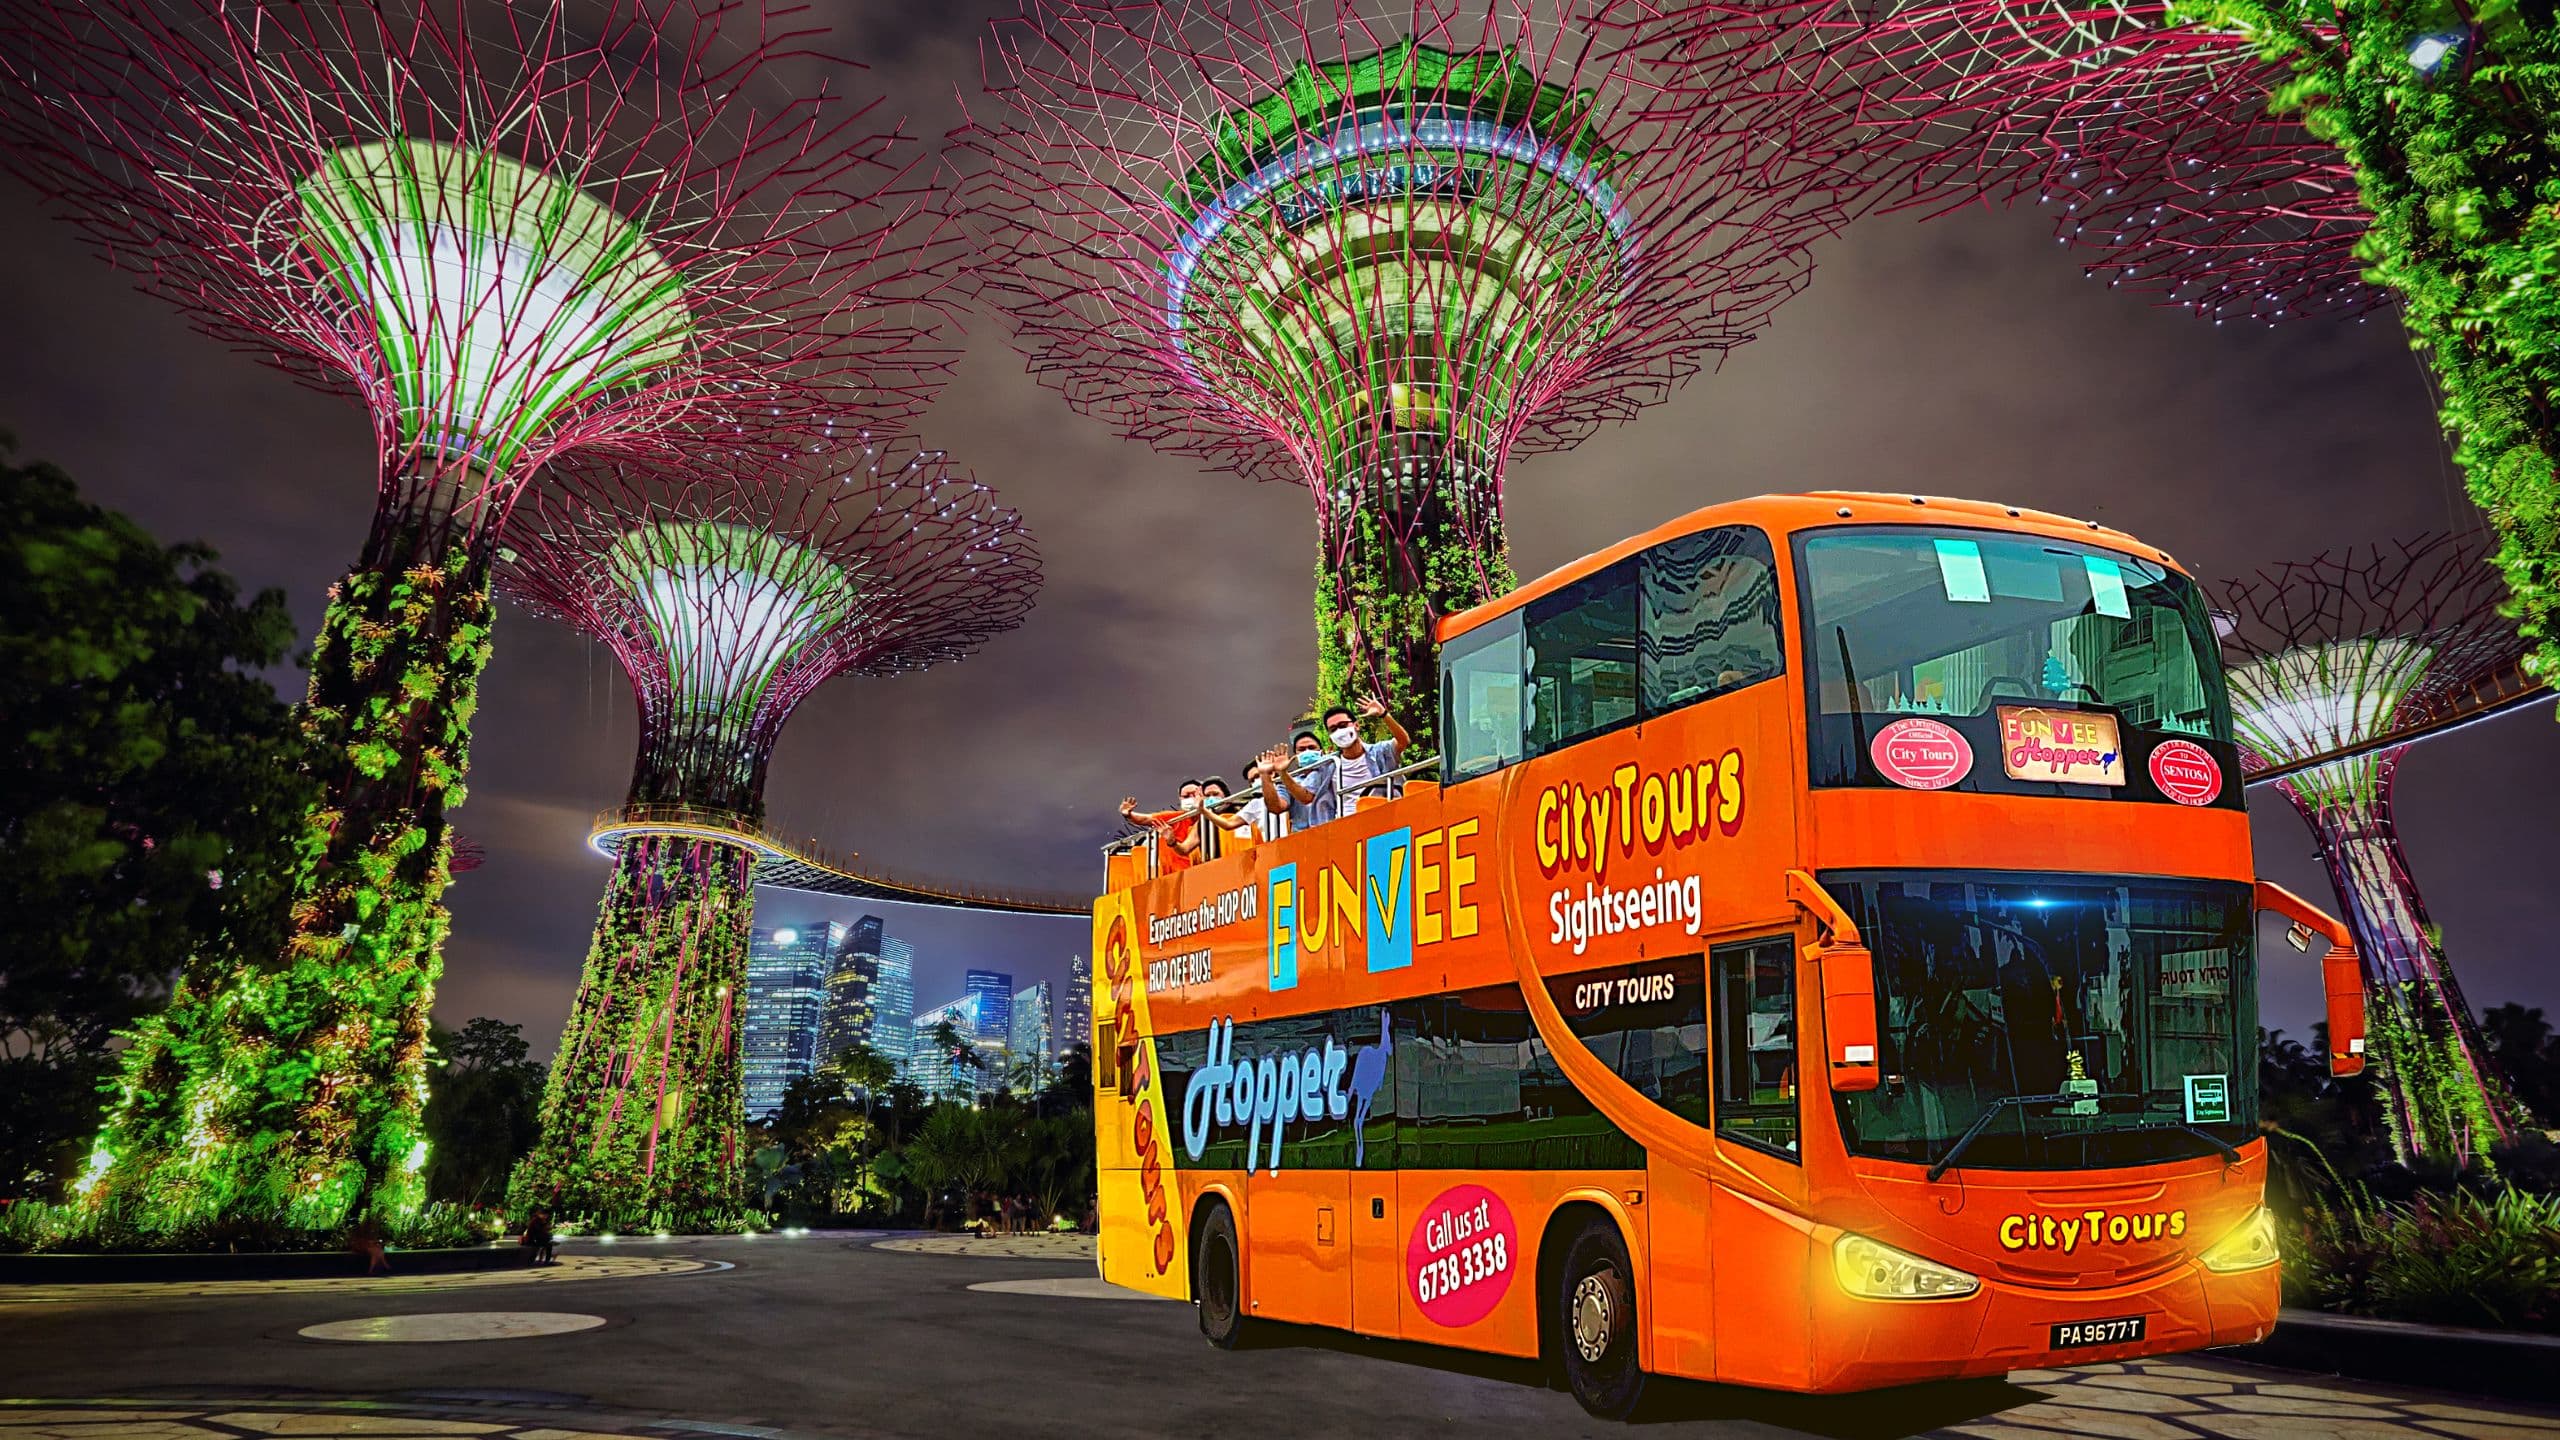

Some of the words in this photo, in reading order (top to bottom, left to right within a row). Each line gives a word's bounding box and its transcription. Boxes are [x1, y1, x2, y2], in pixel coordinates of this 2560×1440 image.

[1892, 748, 1917, 762] City
[1920, 748, 1953, 760] Tours
[2011, 737, 2101, 774] Hopper
[2164, 765, 2208, 781] SENTOSA
[1905, 777, 1929, 788] Since
[1149, 908, 1198, 950] Experience
[1199, 897, 1215, 932] the
[1217, 889, 1239, 927] HOP
[1241, 884, 1257, 920] ON
[1550, 866, 1701, 955] Sightseeing
[1149, 960, 1168, 993] HOP
[1170, 955, 1187, 989] OFF
[1189, 949, 1211, 985] BUS!
[1575, 981, 1613, 1010] CITY
[1617, 974, 1674, 1004] TOURS
[1183, 1014, 1348, 1178] Hopper
[1426, 1210, 1453, 1253] Call
[1455, 1211, 1472, 1240] us
[1474, 1198, 1490, 1232] at
[1419, 1253, 1460, 1303] 6738
[1462, 1233, 1507, 1285] 3338
